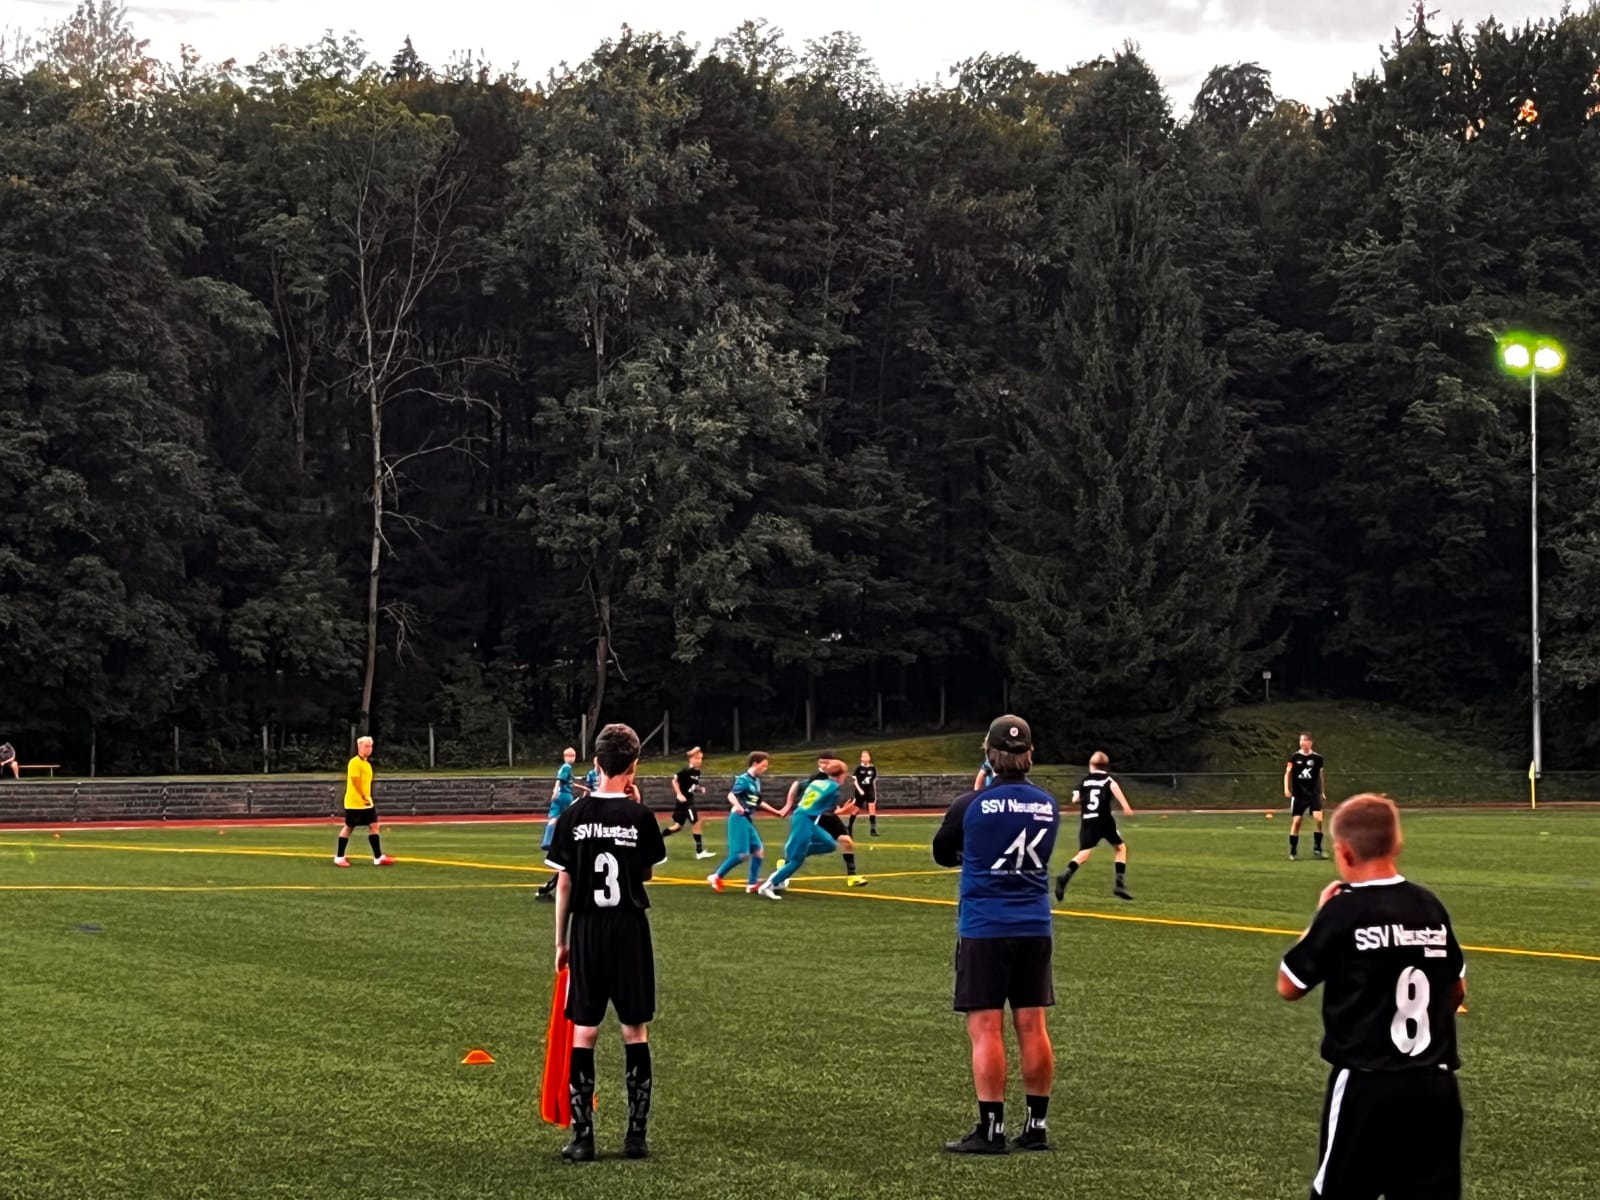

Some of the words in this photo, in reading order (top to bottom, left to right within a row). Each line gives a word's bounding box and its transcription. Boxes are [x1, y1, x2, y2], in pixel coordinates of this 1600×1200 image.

[981, 799, 1005, 814] SSV
[1086, 788, 1101, 811] 5
[572, 823, 592, 840] SSV
[593, 851, 621, 908] 3
[1354, 924, 1389, 951] SSV
[1390, 966, 1431, 1056] 8
